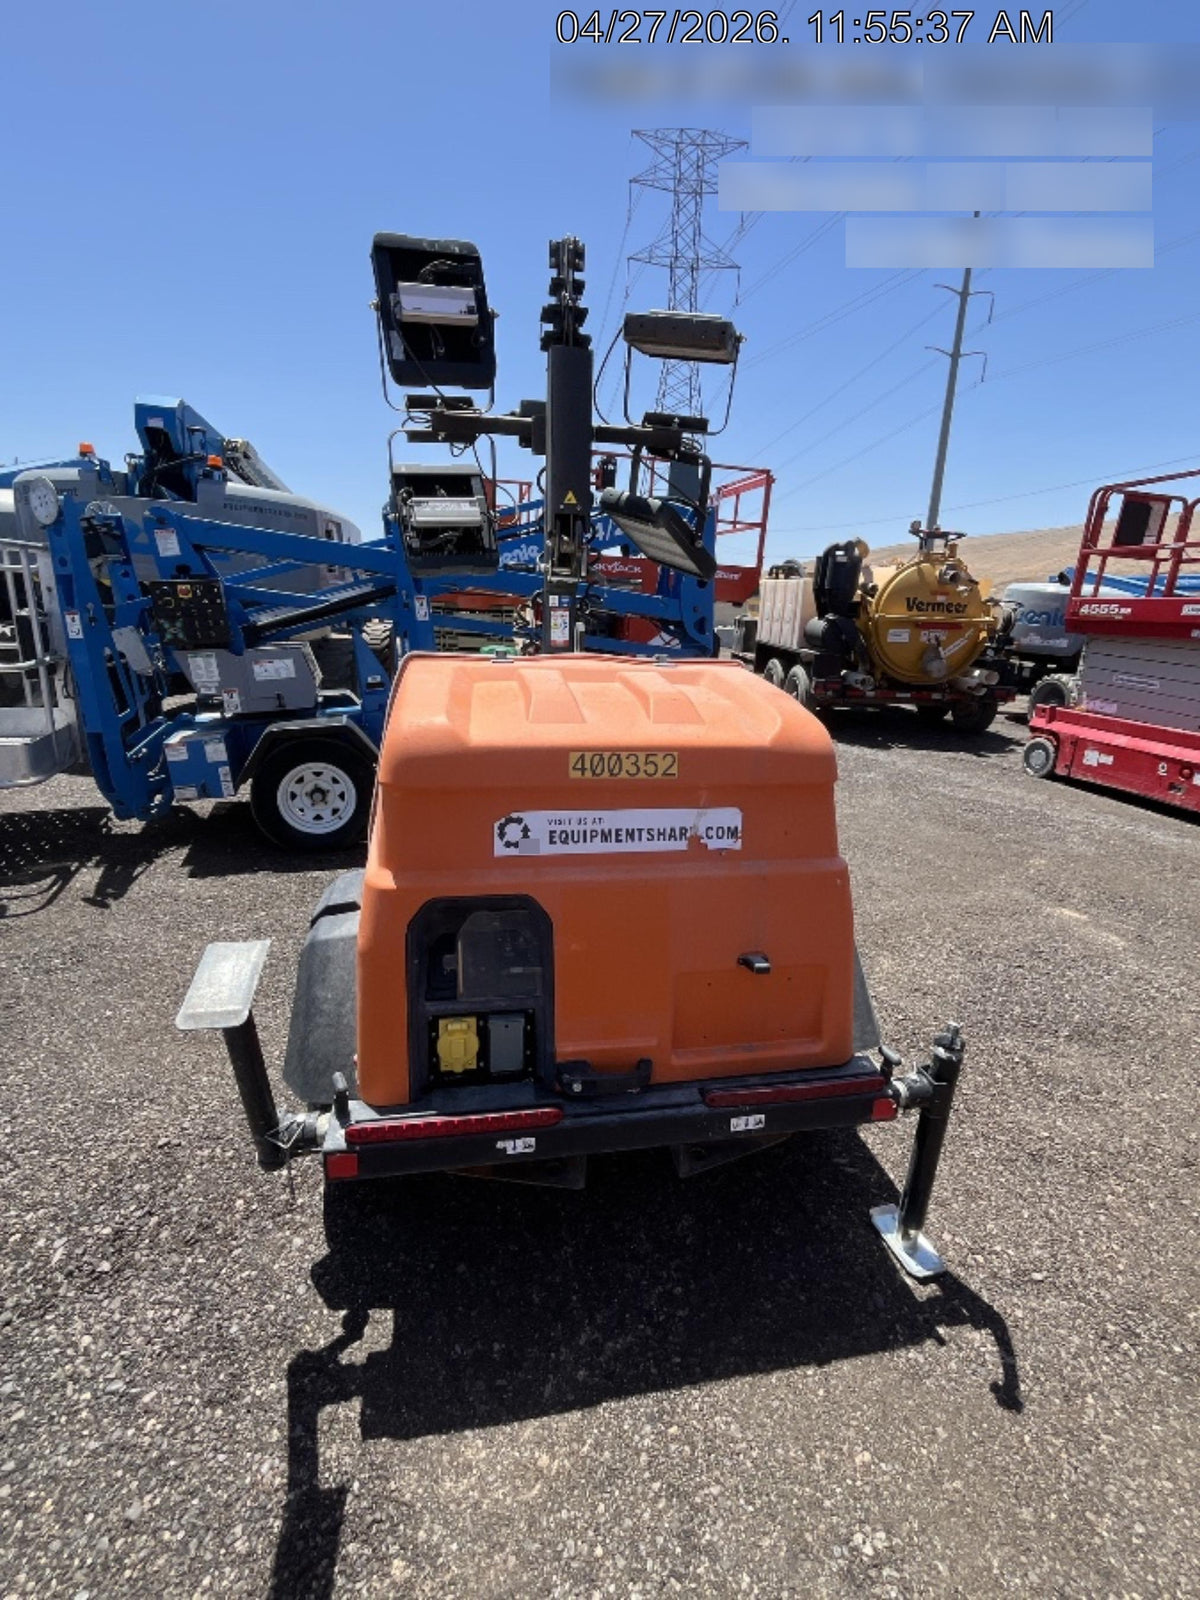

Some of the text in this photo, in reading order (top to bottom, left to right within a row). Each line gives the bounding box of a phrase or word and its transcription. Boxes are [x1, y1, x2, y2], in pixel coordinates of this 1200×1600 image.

[905, 597, 968, 614] Vermeer
[571, 753, 677, 777] 400352
[547, 817, 572, 826] VISIT
[577, 817, 588, 826] US
[548, 825, 740, 846] EQUIPMENTSHAR.COM
